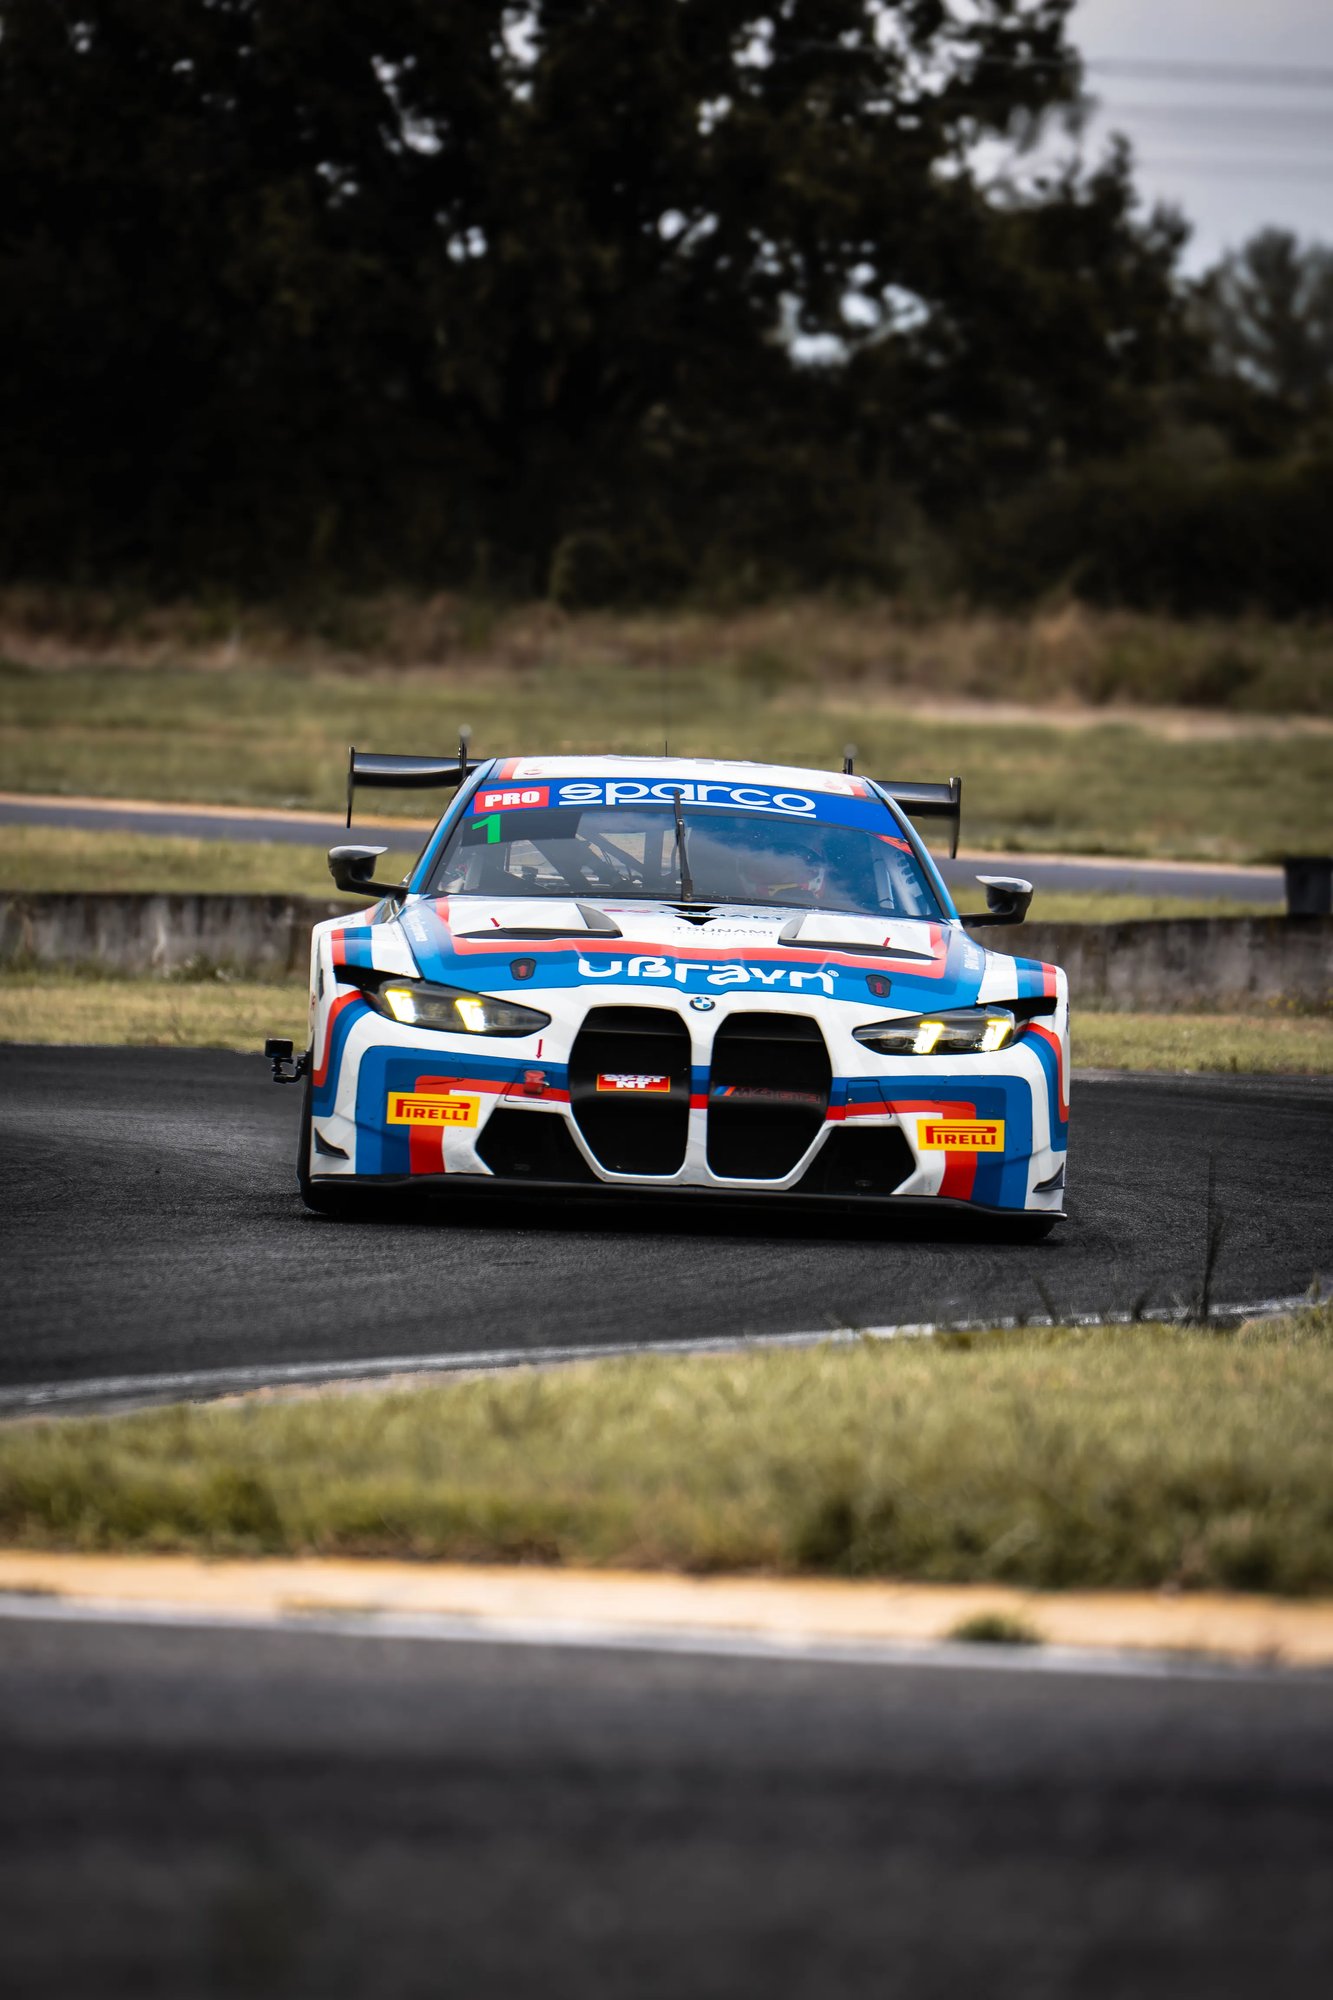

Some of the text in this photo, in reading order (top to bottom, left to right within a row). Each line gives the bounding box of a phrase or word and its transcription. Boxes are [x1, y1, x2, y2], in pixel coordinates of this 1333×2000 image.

[484, 790, 540, 807] PRO
[559, 782, 816, 811] sparco
[472, 814, 501, 844] 1
[675, 926, 773, 935] TSUNAMI
[395, 1099, 471, 1121] PIRELLI
[926, 1126, 997, 1145] PIRELLI
